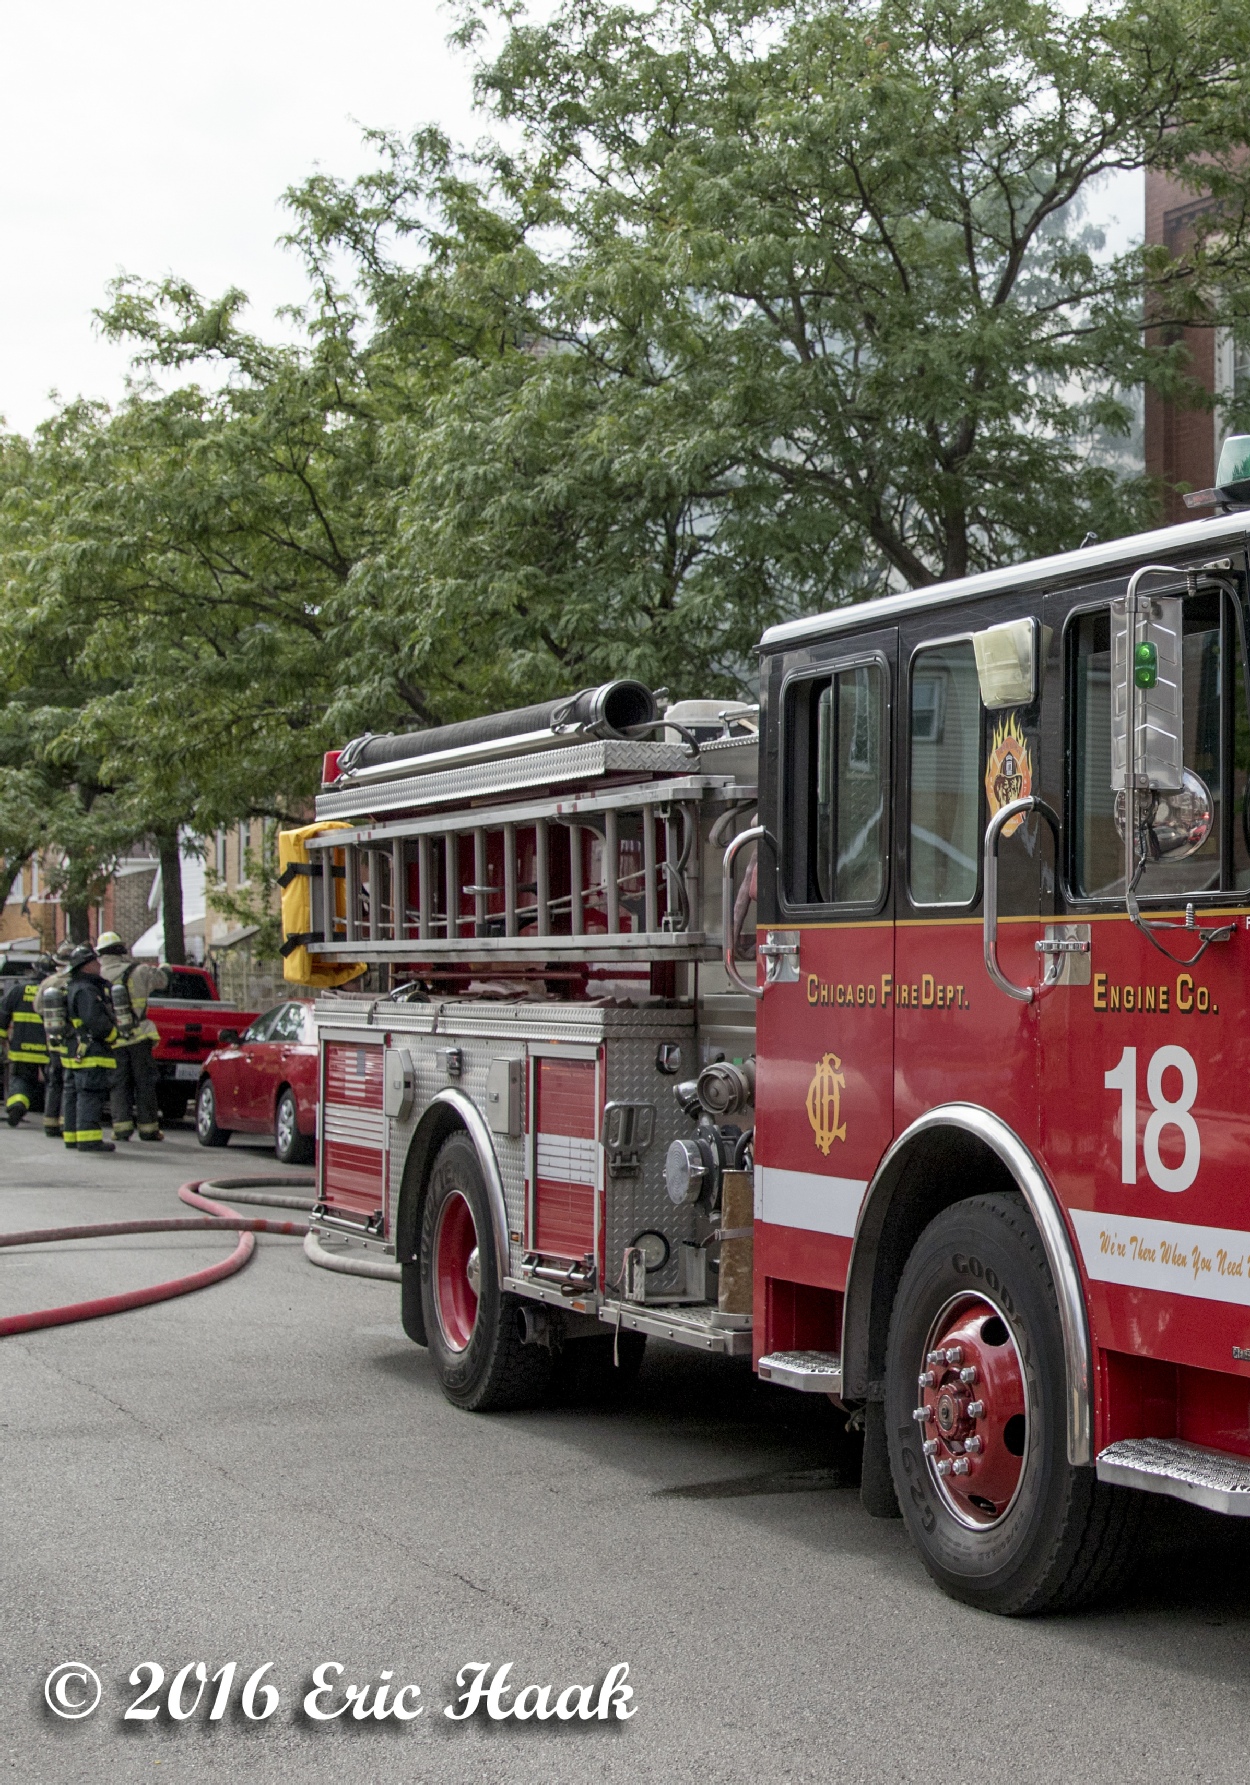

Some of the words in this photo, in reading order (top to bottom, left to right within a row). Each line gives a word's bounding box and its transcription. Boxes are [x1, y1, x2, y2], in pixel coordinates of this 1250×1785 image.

[1105, 1045, 1200, 1192] 18
[1099, 1230, 1127, 1257] We're
[1129, 1235, 1156, 1263] There
[1160, 1240, 1188, 1268] When
[1191, 1245, 1212, 1280] You
[1216, 1248, 1244, 1276] Need
